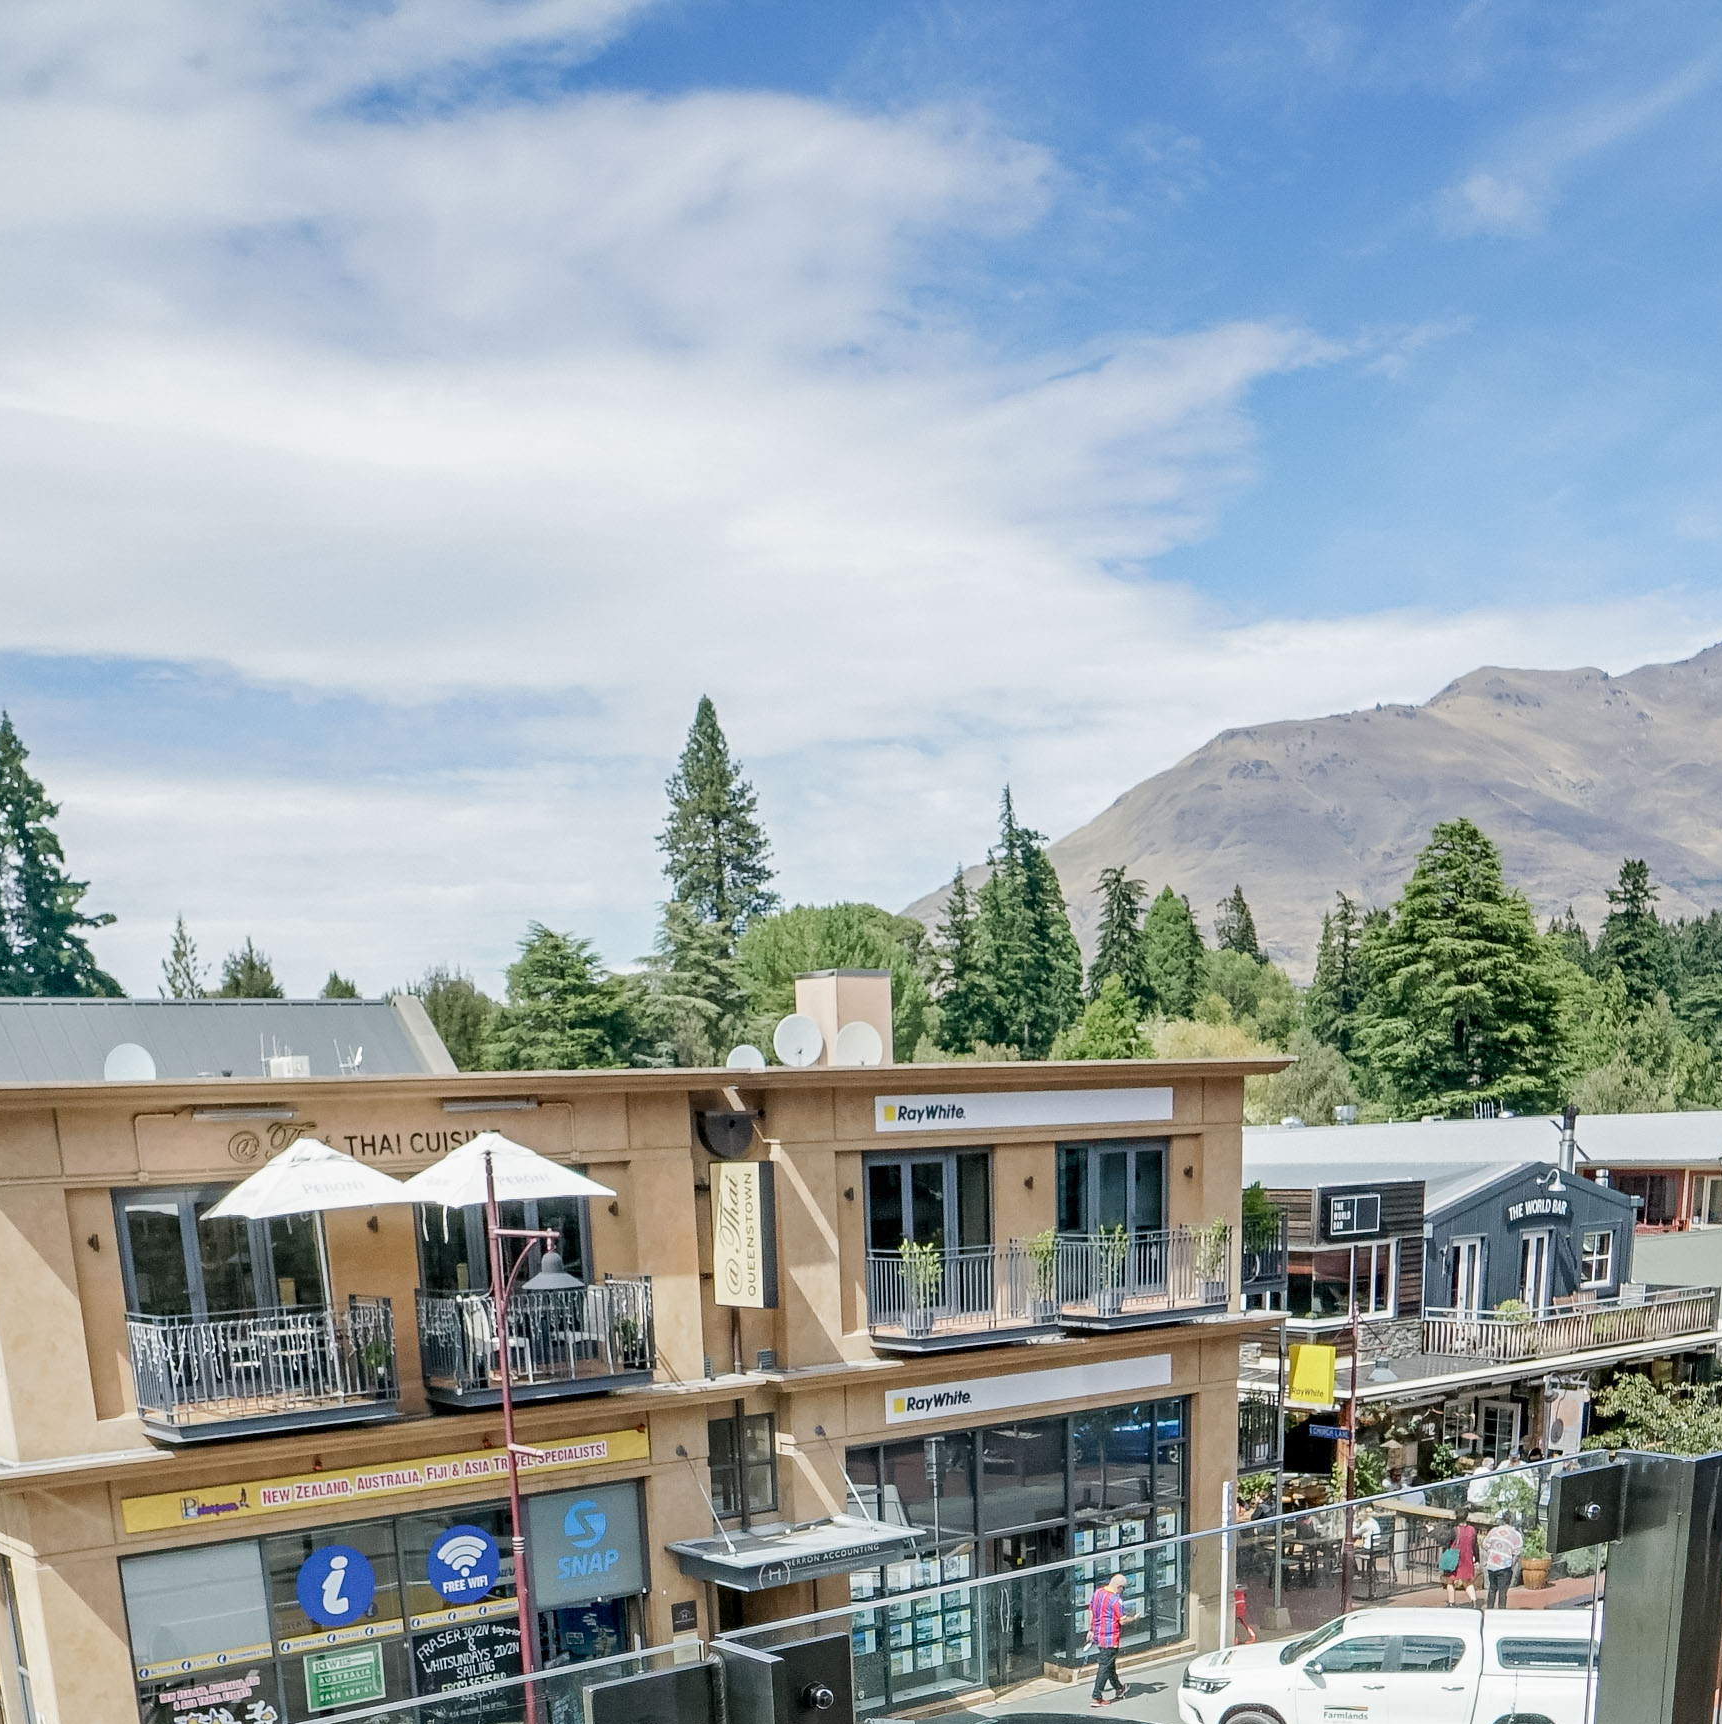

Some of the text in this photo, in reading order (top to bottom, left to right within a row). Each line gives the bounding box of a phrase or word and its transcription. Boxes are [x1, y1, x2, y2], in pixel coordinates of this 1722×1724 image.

[344, 1134, 401, 1156] THAI
[409, 1129, 500, 1153] CUISI
[1333, 1201, 1344, 1211] THE
[1333, 1211, 1352, 1221] WORLD
[1508, 1199, 1568, 1222] THE WORLD BAR
[743, 1172, 757, 1297] QUEENSTOWN
[1333, 1221, 1344, 1231] BAR
[1292, 1387, 1324, 1398] RayWhite
[262, 1488, 290, 1504] NEW
[296, 1480, 353, 1500] ZEALAND,
[357, 1470, 424, 1491] AUSTRALIA,
[427, 1466, 447, 1481] FIJI
[452, 1463, 460, 1477] &
[464, 1459, 489, 1475] ASIA
[493, 1453, 534, 1472] TRVEL
[557, 1549, 620, 1580] SNAP
[786, 1543, 880, 1567] HERRON ACCOUNTING
[442, 1574, 489, 1594] FREE WIFI
[417, 1629, 461, 1661] FRASER
[467, 1638, 476, 1652] &
[422, 1642, 520, 1673] WHITSUNDAYS 2D/2N
[318, 1669, 372, 1686] AUSTRALIA
[457, 1660, 495, 1680] SAILING
[319, 1691, 341, 1702] SAVE
[1323, 1711, 1368, 1721] Farmlands
